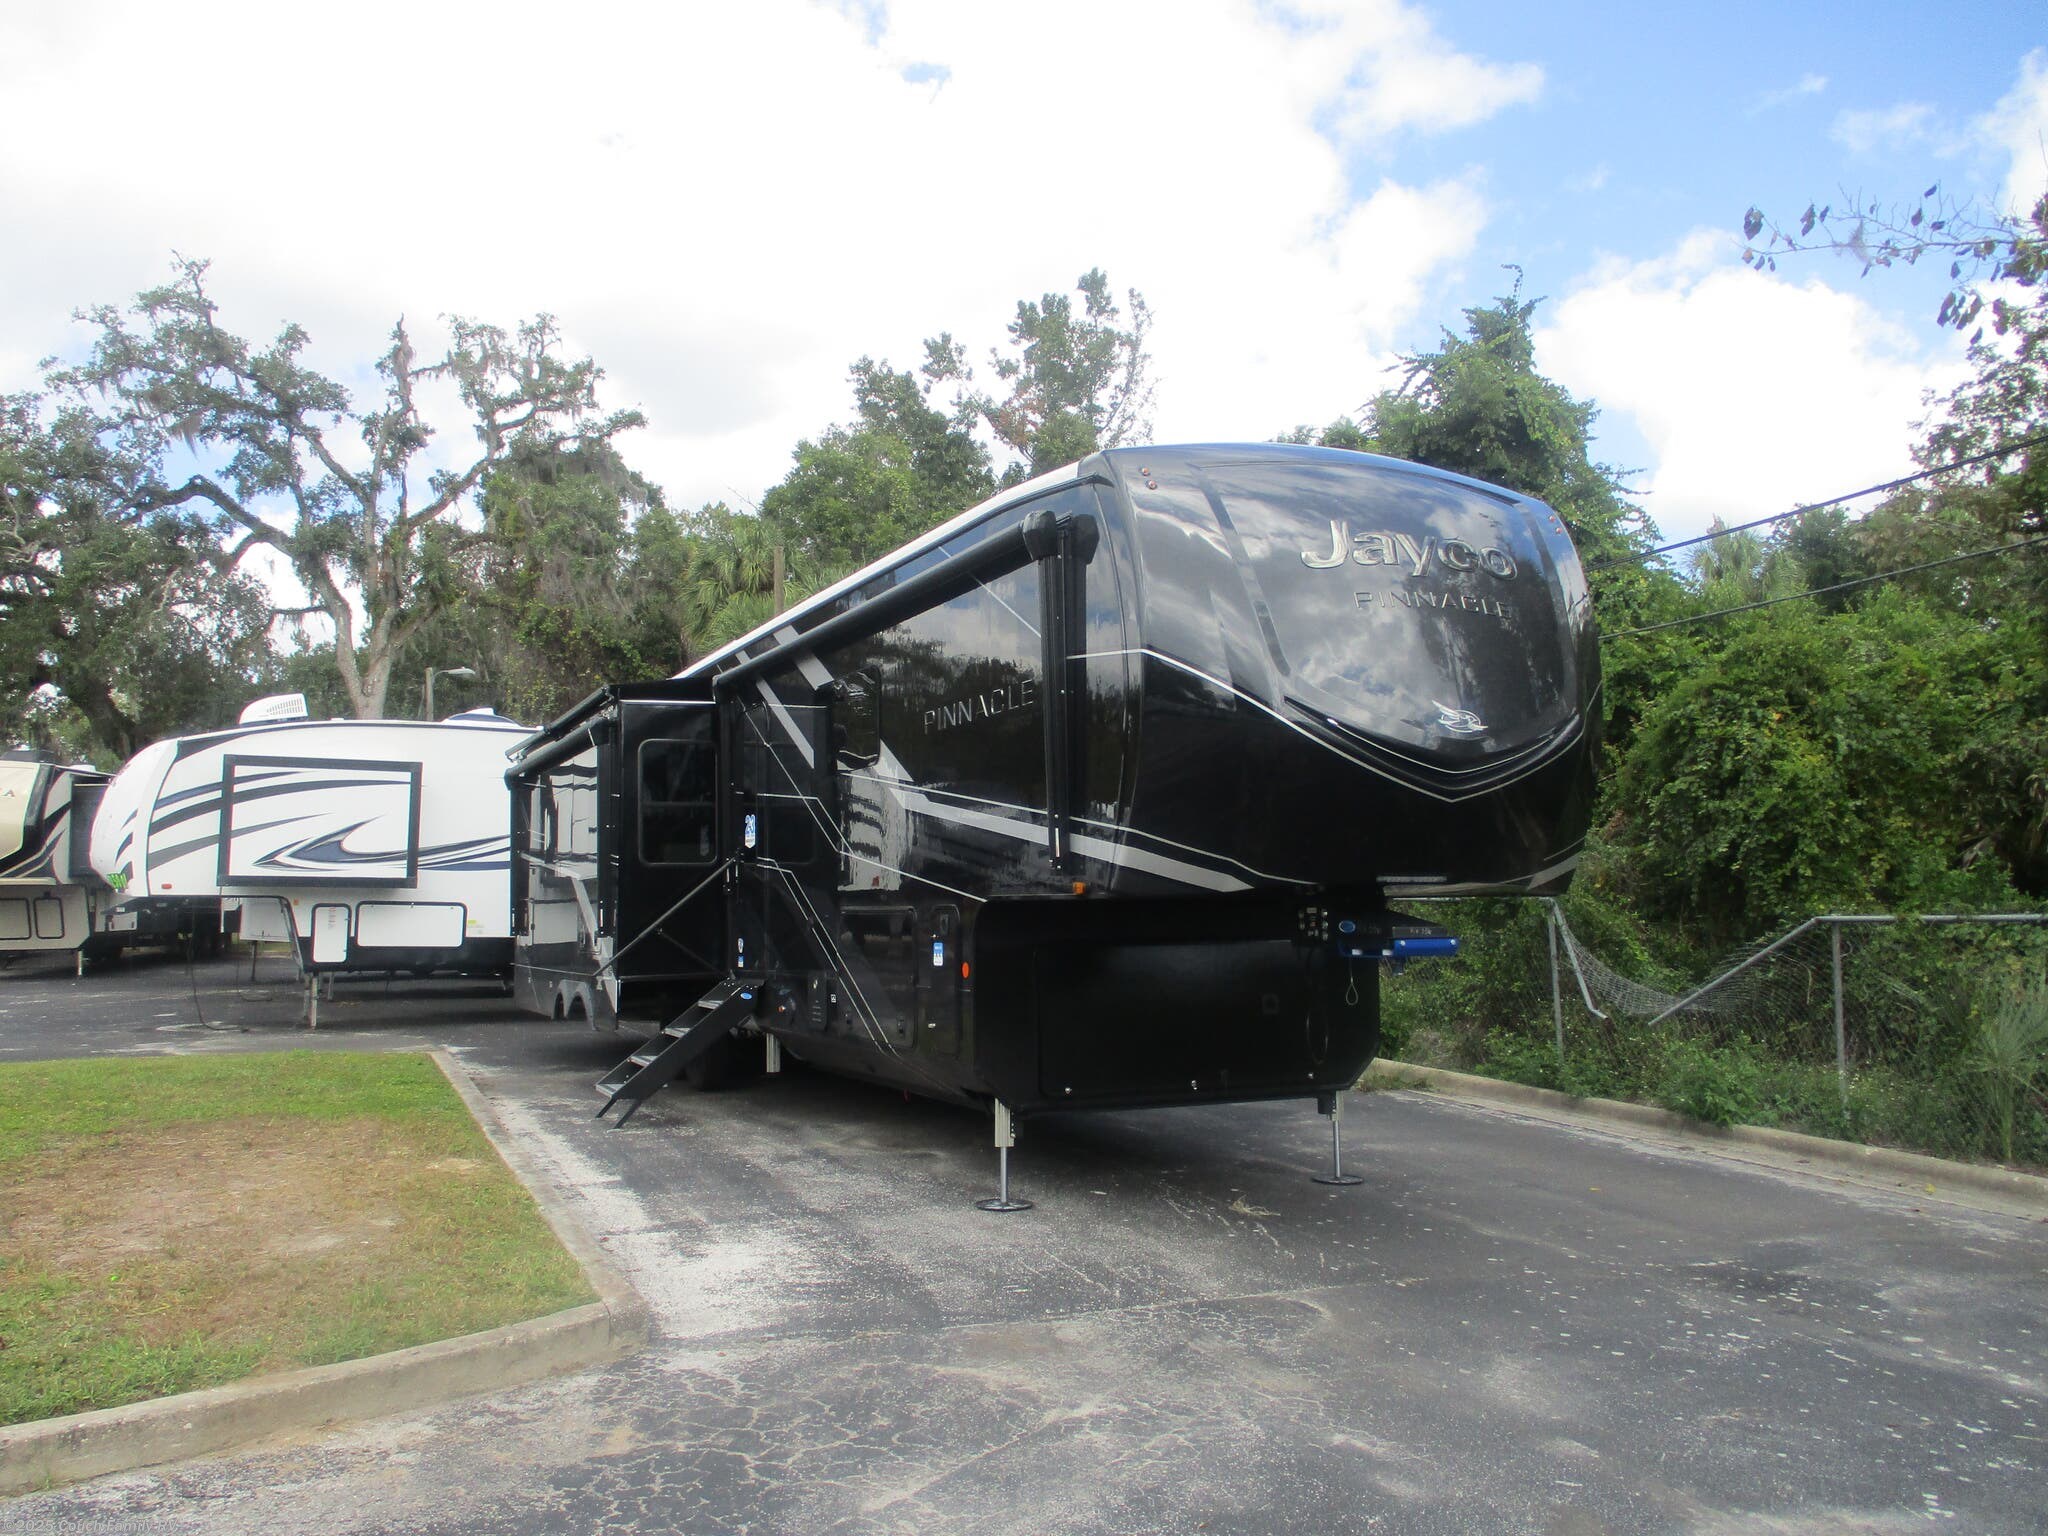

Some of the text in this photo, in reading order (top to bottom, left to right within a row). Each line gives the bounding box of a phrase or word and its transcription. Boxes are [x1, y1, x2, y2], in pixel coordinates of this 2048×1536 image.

[1301, 519, 1518, 580] Jayco
[1353, 591, 1513, 618] PINNACLE
[923, 678, 1035, 736] PINNACLE
